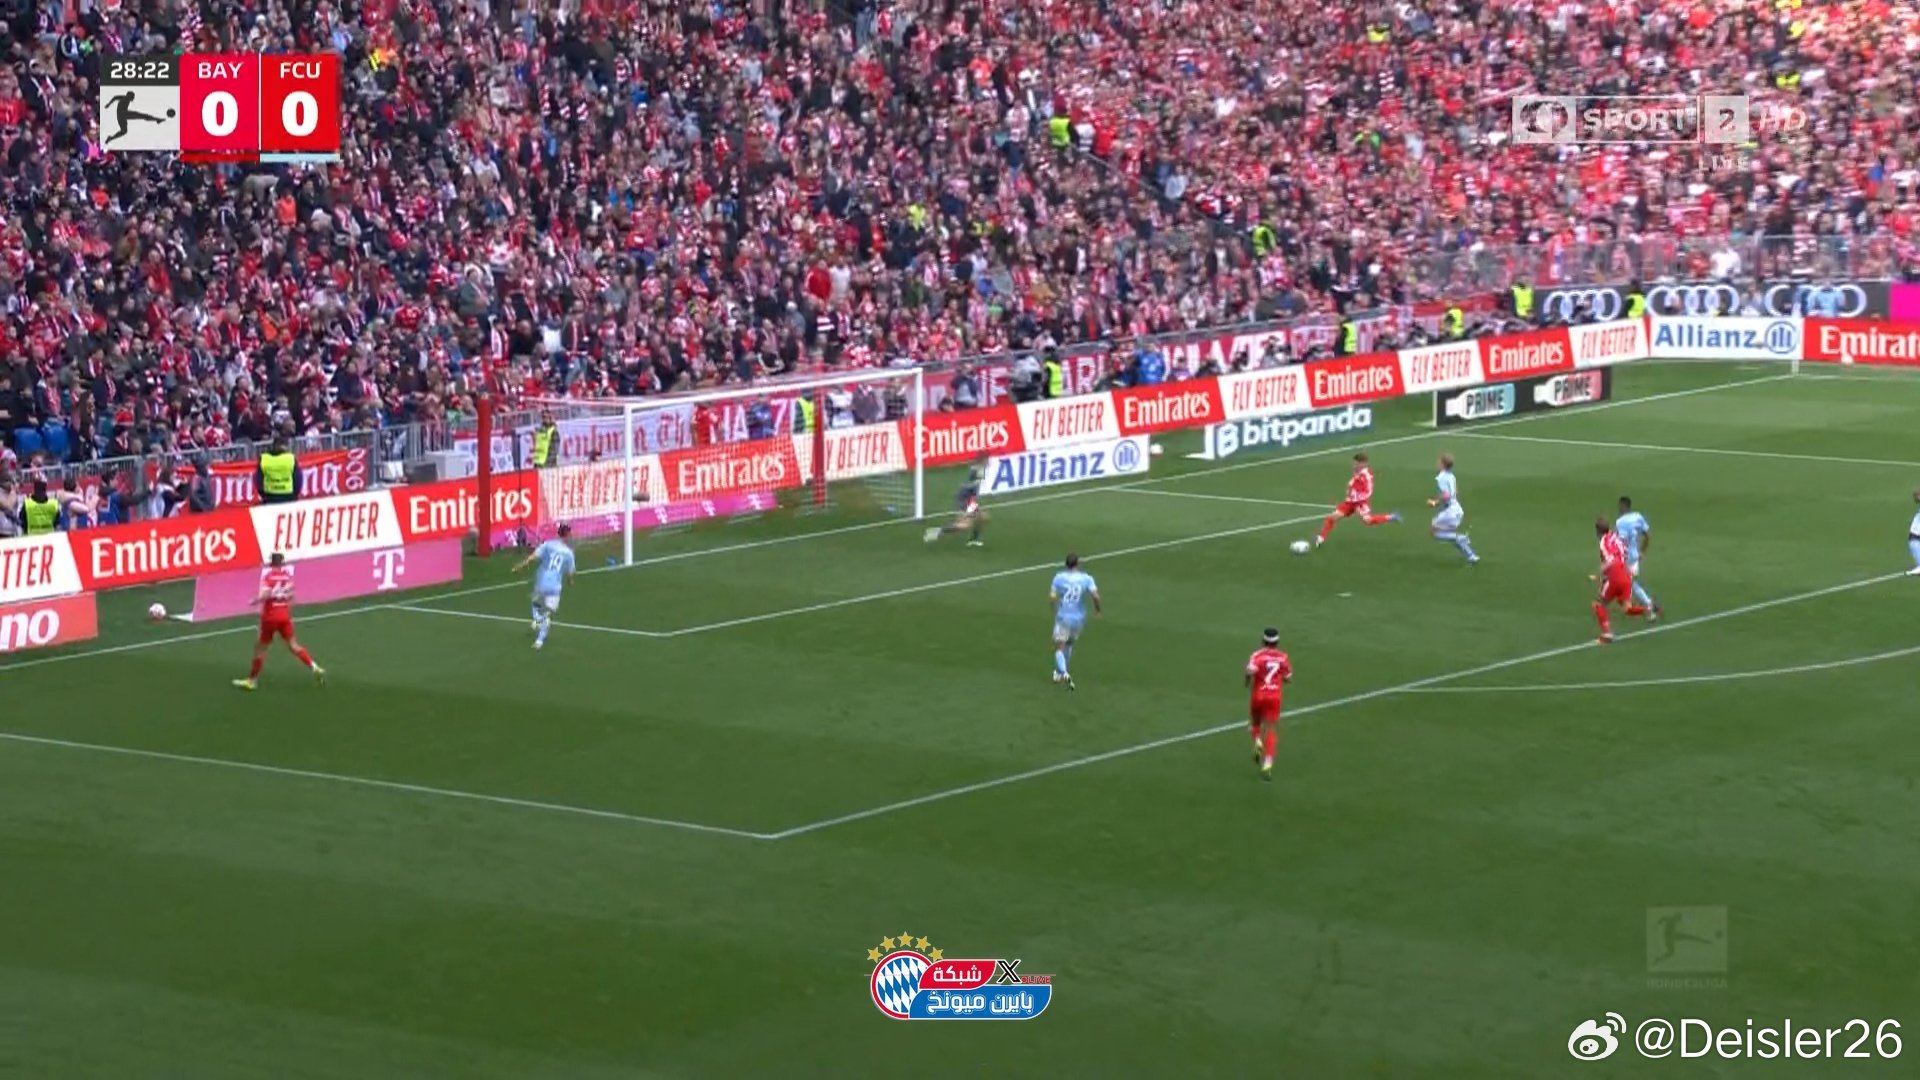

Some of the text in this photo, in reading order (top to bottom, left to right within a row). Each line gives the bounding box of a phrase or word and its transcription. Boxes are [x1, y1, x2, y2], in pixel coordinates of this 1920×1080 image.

[1581, 326, 1637, 358] FLY BETTER
[1655, 324, 1756, 348] Allianz
[1411, 349, 1471, 384] FLY BETTER
[1490, 341, 1563, 374] Emirates
[1232, 373, 1297, 411] FLY BETTER
[1315, 364, 1393, 400] Emirates
[1553, 376, 1592, 401] PRIME
[1033, 402, 1105, 441] FLY BETTER
[1124, 391, 1210, 428] Emirates
[1466, 390, 1504, 416] PRIME
[1243, 407, 1371, 446] bitpanda
[837, 430, 889, 471] BETTER
[678, 452, 785, 494] Emirates
[992, 451, 1105, 491] Allianz
[274, 502, 379, 550] FLY BETTER
[409, 487, 532, 534] Emirtes
[91, 529, 236, 579] Emirates
[1265, 661, 1280, 684] 7
